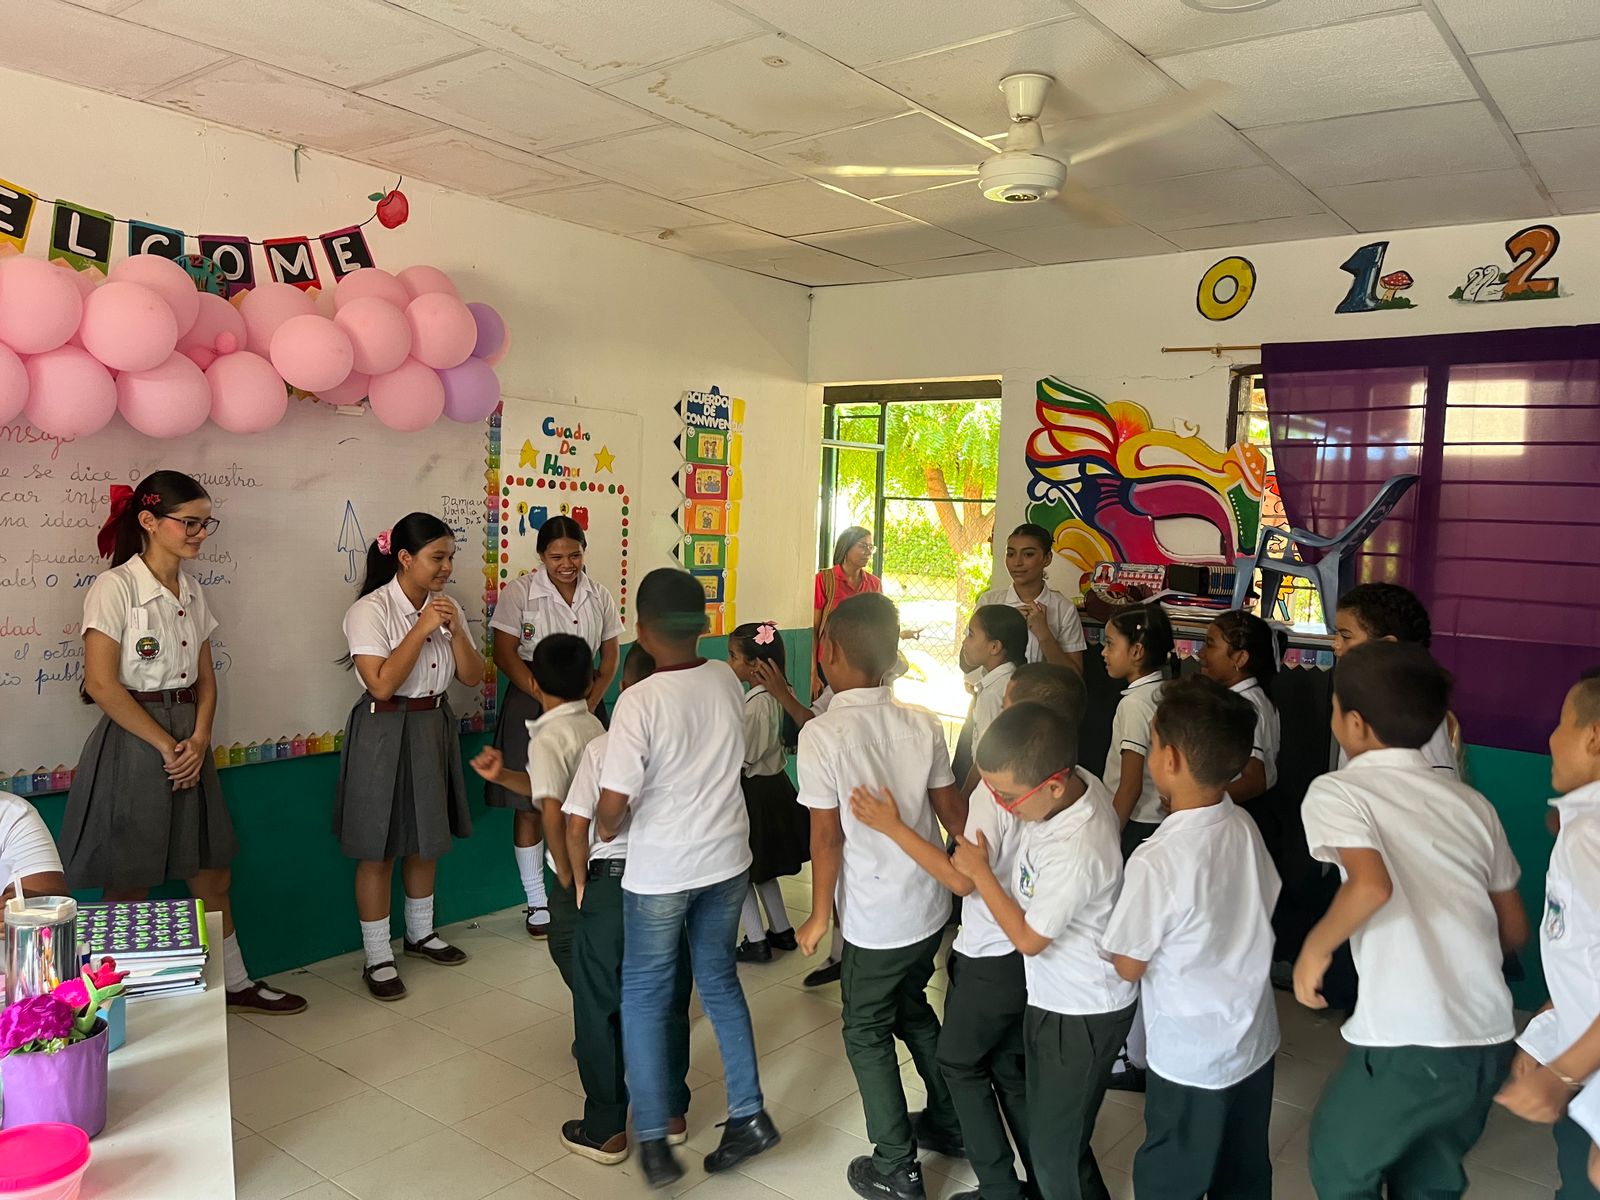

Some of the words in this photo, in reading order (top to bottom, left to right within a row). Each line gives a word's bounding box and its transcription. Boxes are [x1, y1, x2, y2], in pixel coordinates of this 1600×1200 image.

[1335, 241, 1390, 314] 1
[1505, 224, 1561, 296] 2
[687, 392, 729, 408] ACUERDO
[703, 405, 716, 416] DE
[542, 416, 591, 441] Cuadro
[685, 412, 742, 431] CONVIVEN
[560, 440, 577, 455] De
[70, 462, 118, 482] dice
[543, 453, 580, 477] Honor
